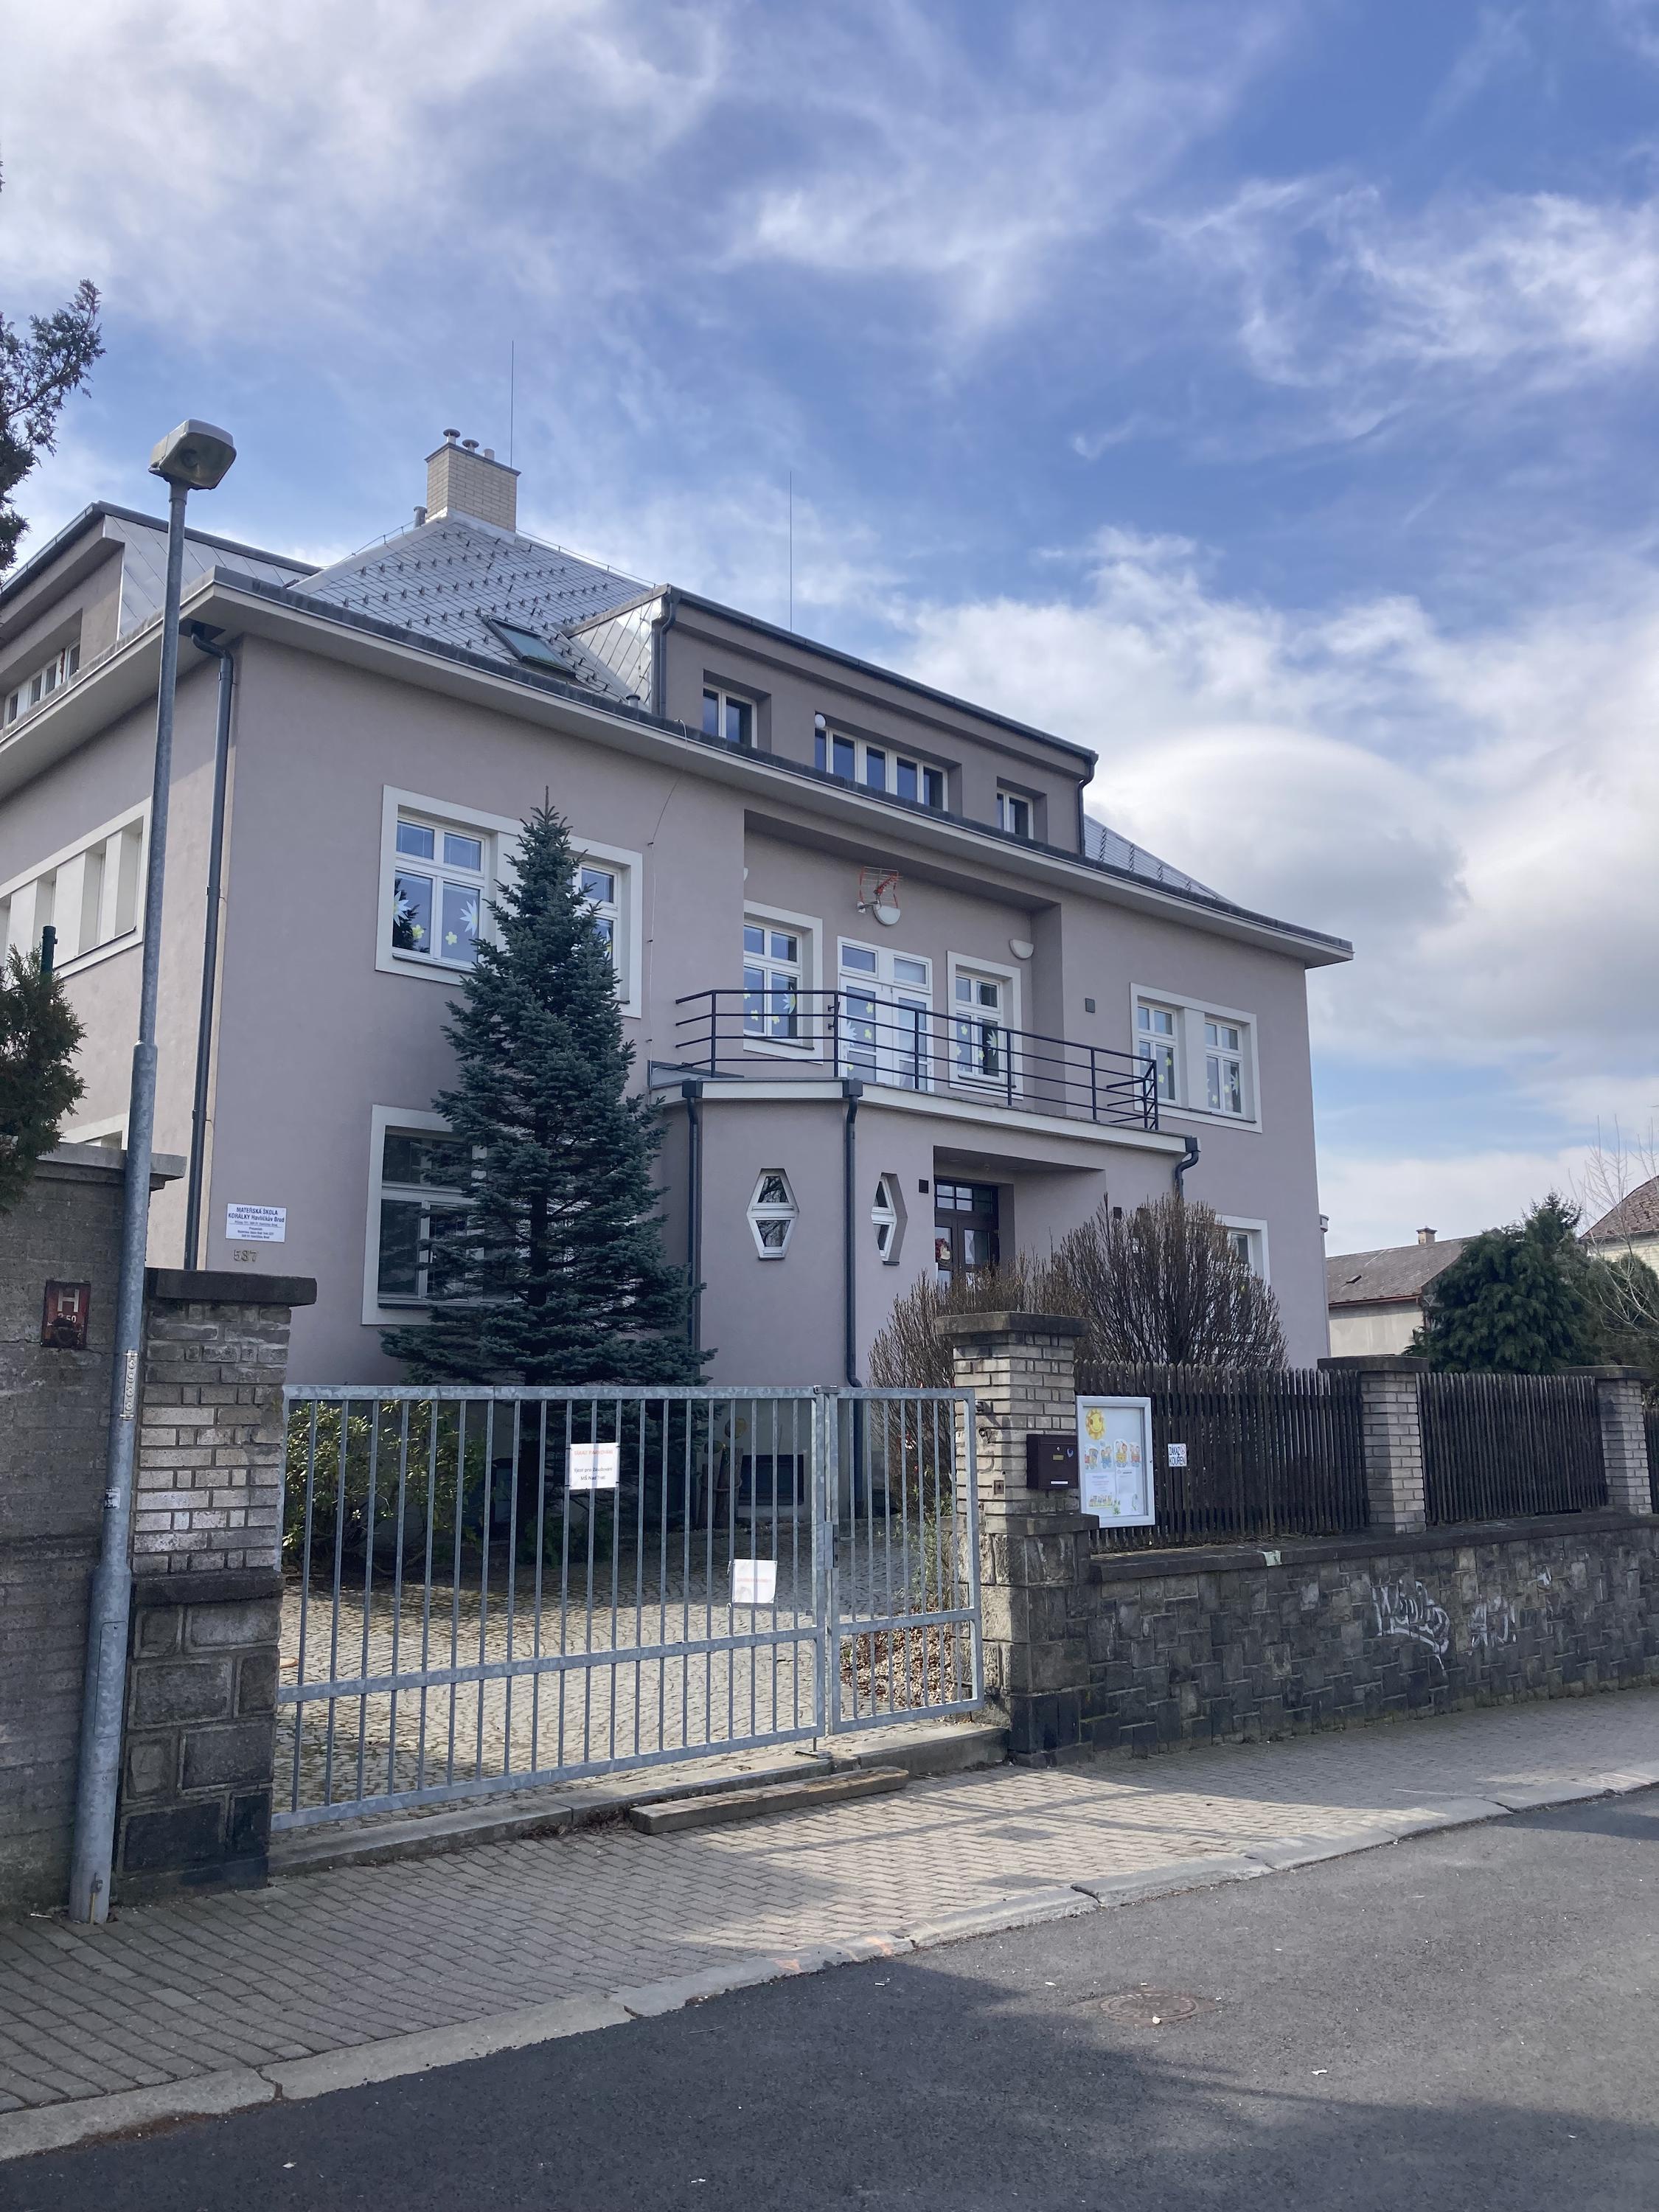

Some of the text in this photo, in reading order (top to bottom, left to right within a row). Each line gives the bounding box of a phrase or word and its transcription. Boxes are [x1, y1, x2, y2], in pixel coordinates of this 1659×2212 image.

[236, 1206, 278, 1216] MATEŘSKÁ ŠKOLA
[58, 1289, 80, 1312] H
[1169, 1445, 1180, 1455] ZÁKAZ
